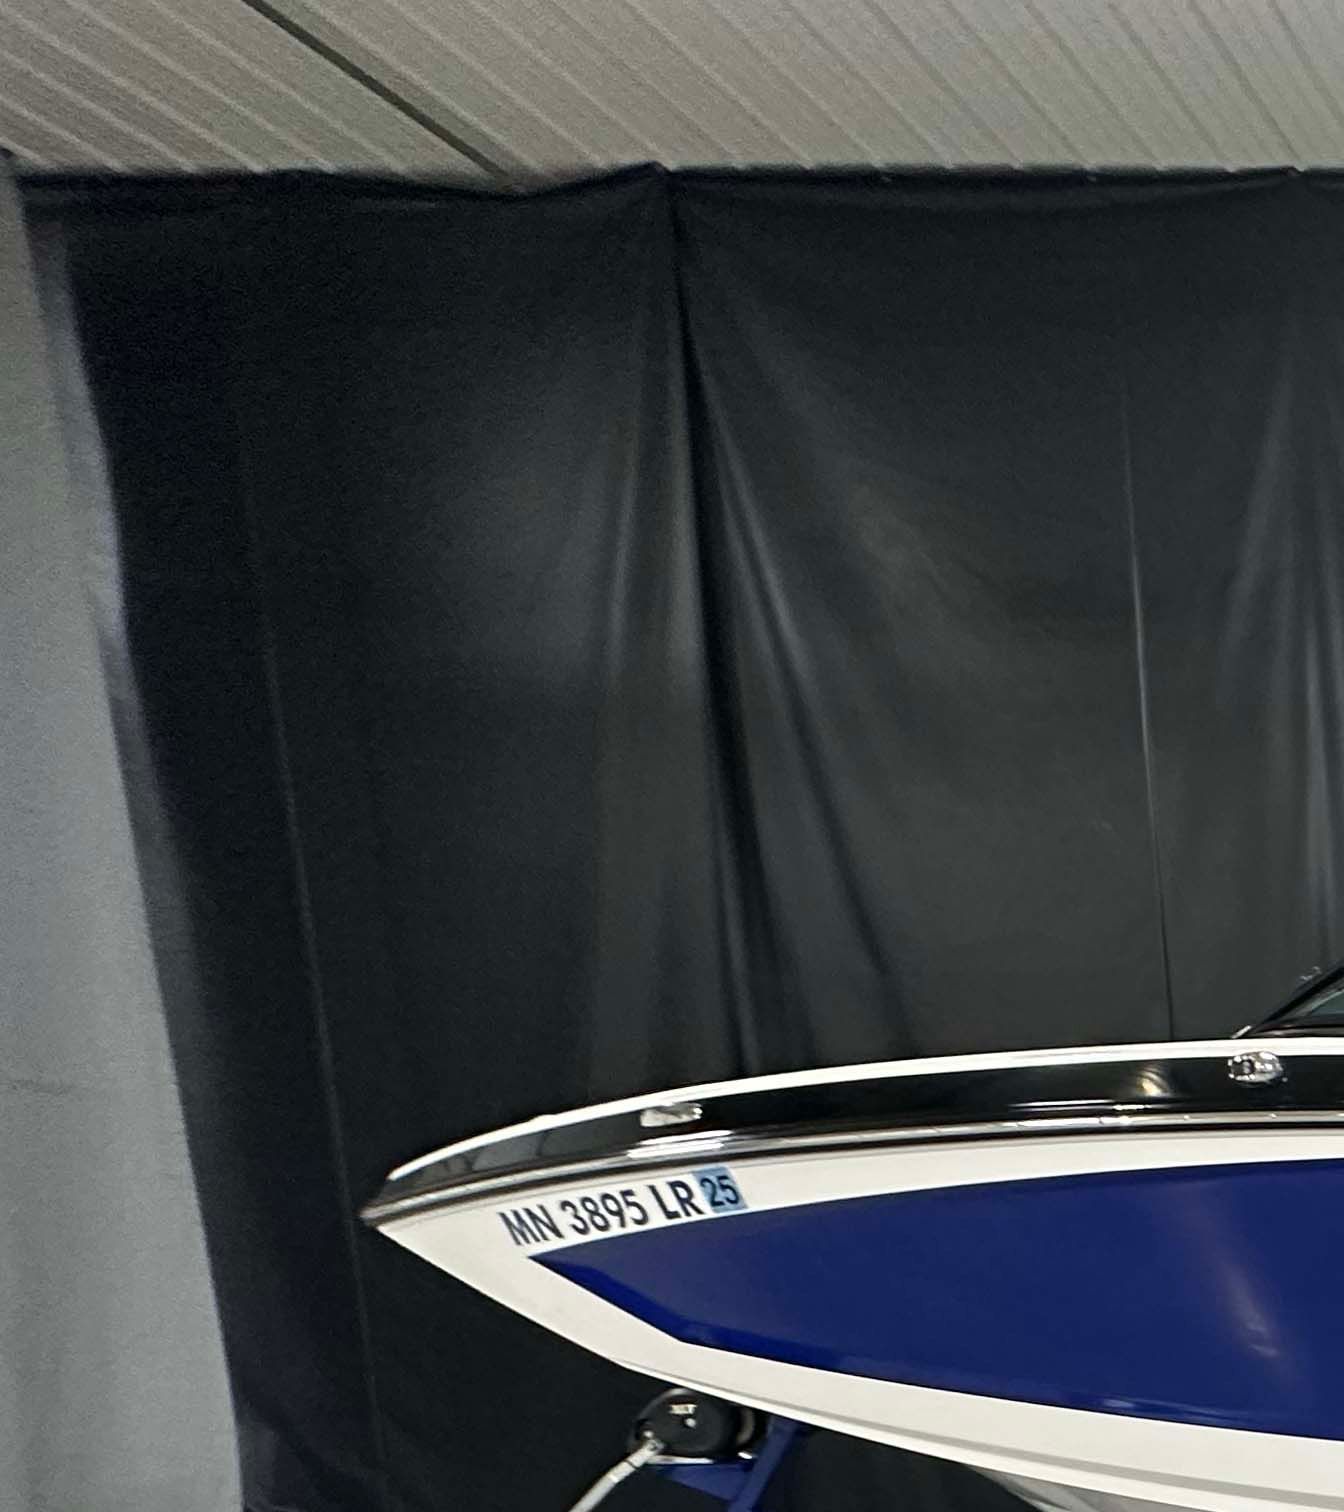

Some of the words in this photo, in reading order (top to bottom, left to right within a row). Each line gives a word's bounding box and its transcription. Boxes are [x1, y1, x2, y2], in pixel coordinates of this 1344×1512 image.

[497, 1204, 565, 1246] MN
[560, 1188, 650, 1236] 3895
[646, 1180, 705, 1221] LR
[700, 1174, 741, 1208] 25
